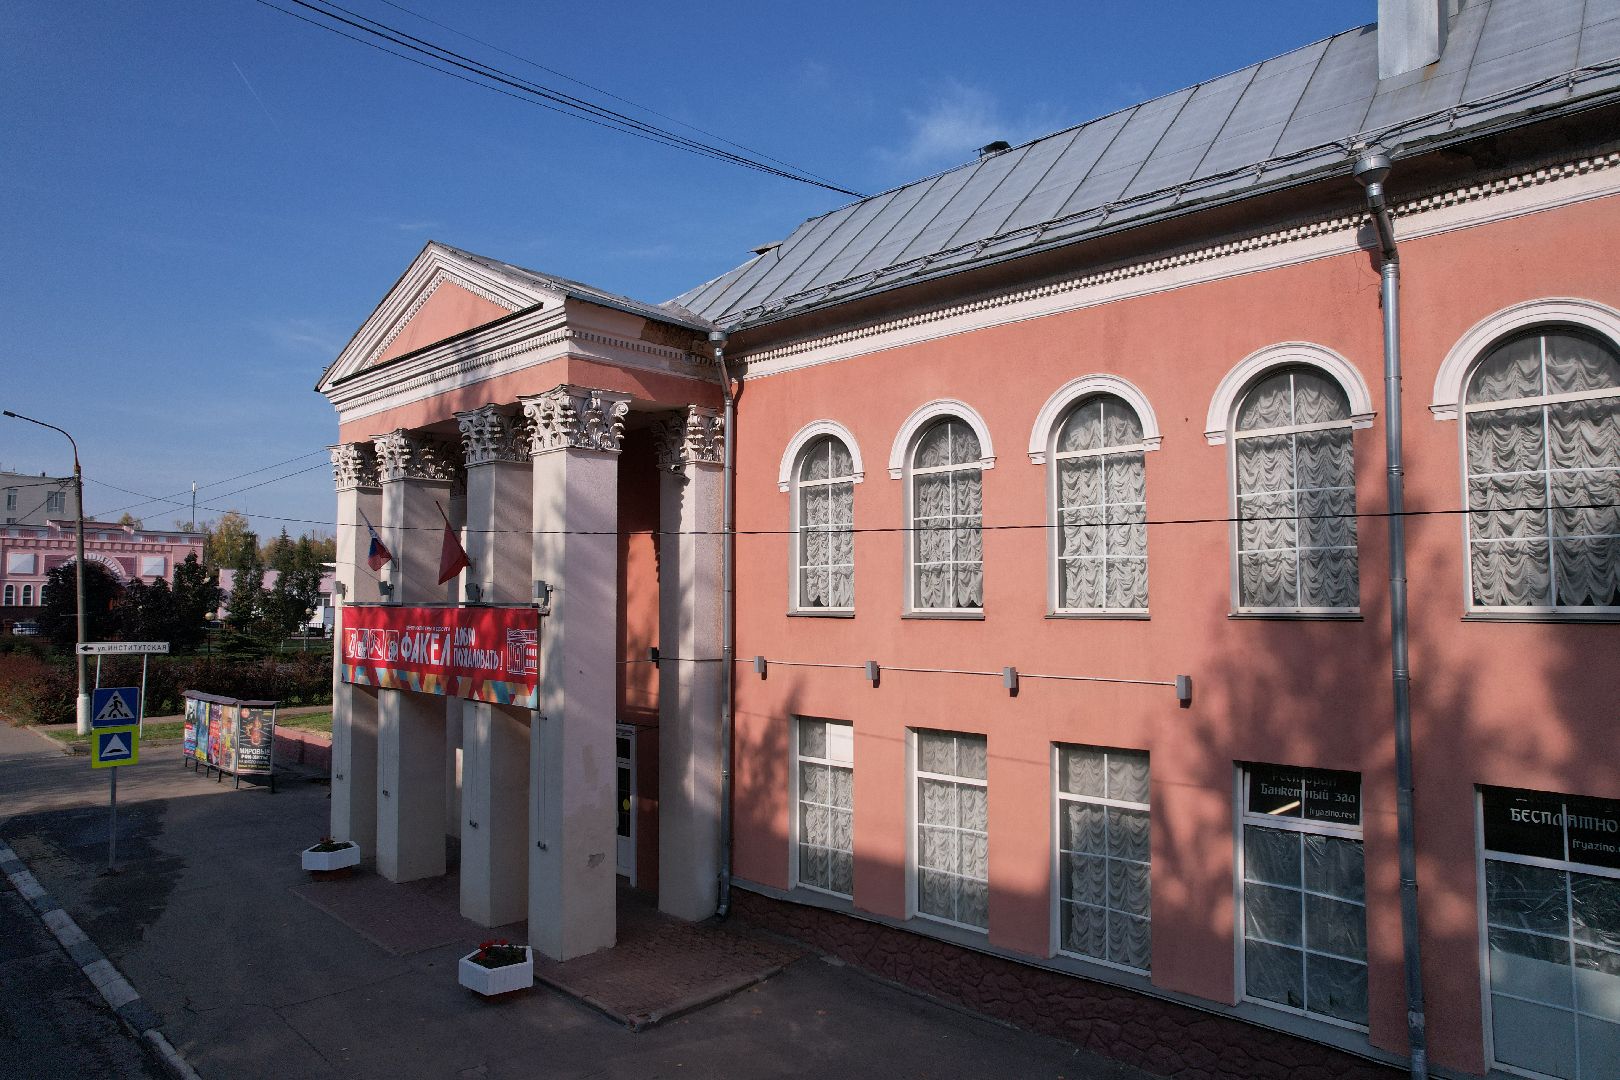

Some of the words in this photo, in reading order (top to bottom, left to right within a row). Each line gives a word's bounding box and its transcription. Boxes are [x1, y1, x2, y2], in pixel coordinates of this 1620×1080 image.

[453, 626, 476, 646] ДОБРО
[400, 631, 450, 667] ФАКЕЛ
[1261, 783, 1329, 800] Банкетный
[1335, 792, 1356, 803] зал
